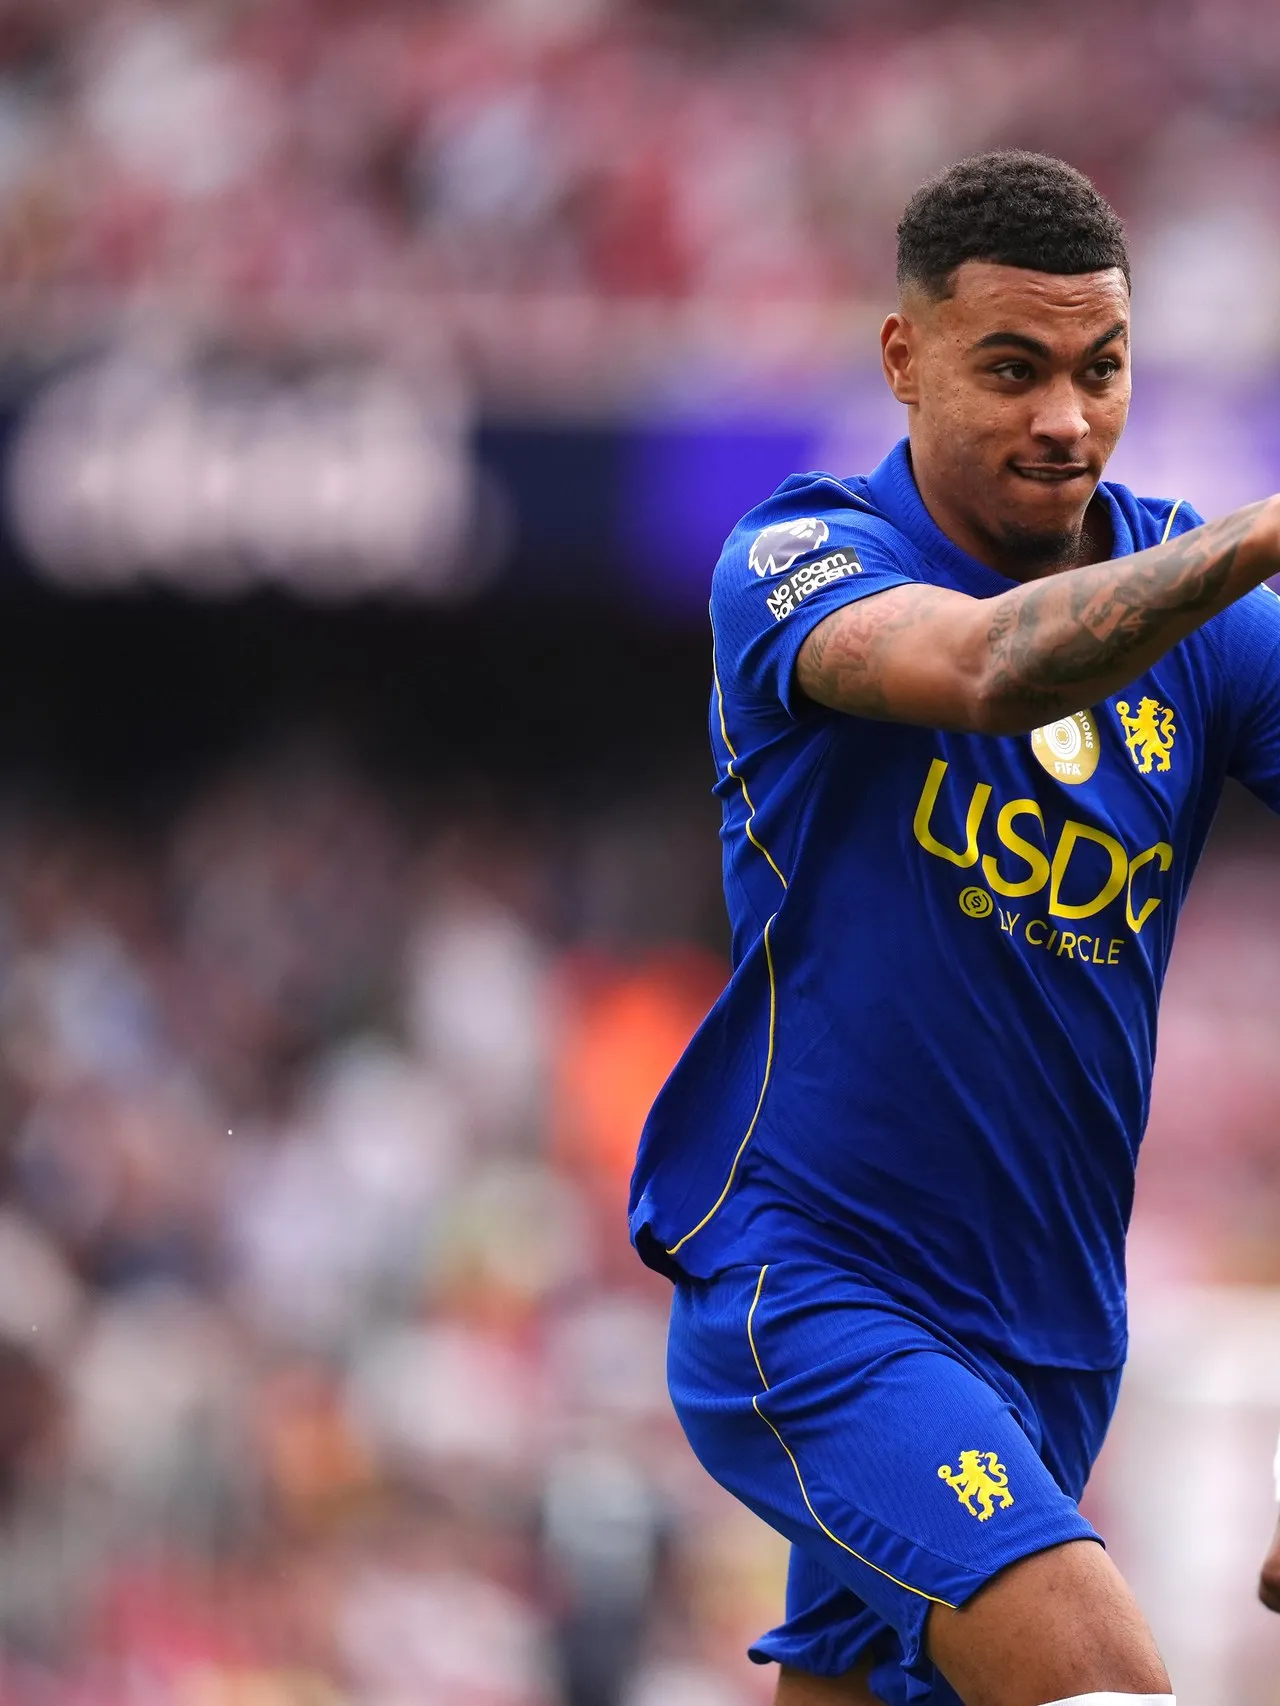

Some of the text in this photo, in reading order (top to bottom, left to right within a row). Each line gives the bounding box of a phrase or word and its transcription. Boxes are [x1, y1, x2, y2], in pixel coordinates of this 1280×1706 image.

[766, 553, 847, 617] No room
[795, 562, 863, 602] racism
[1075, 710, 1094, 749] PIONS
[1054, 761, 1082, 776] FIFA
[913, 757, 1173, 934] USDC
[1025, 919, 1125, 965] CIRCLE
